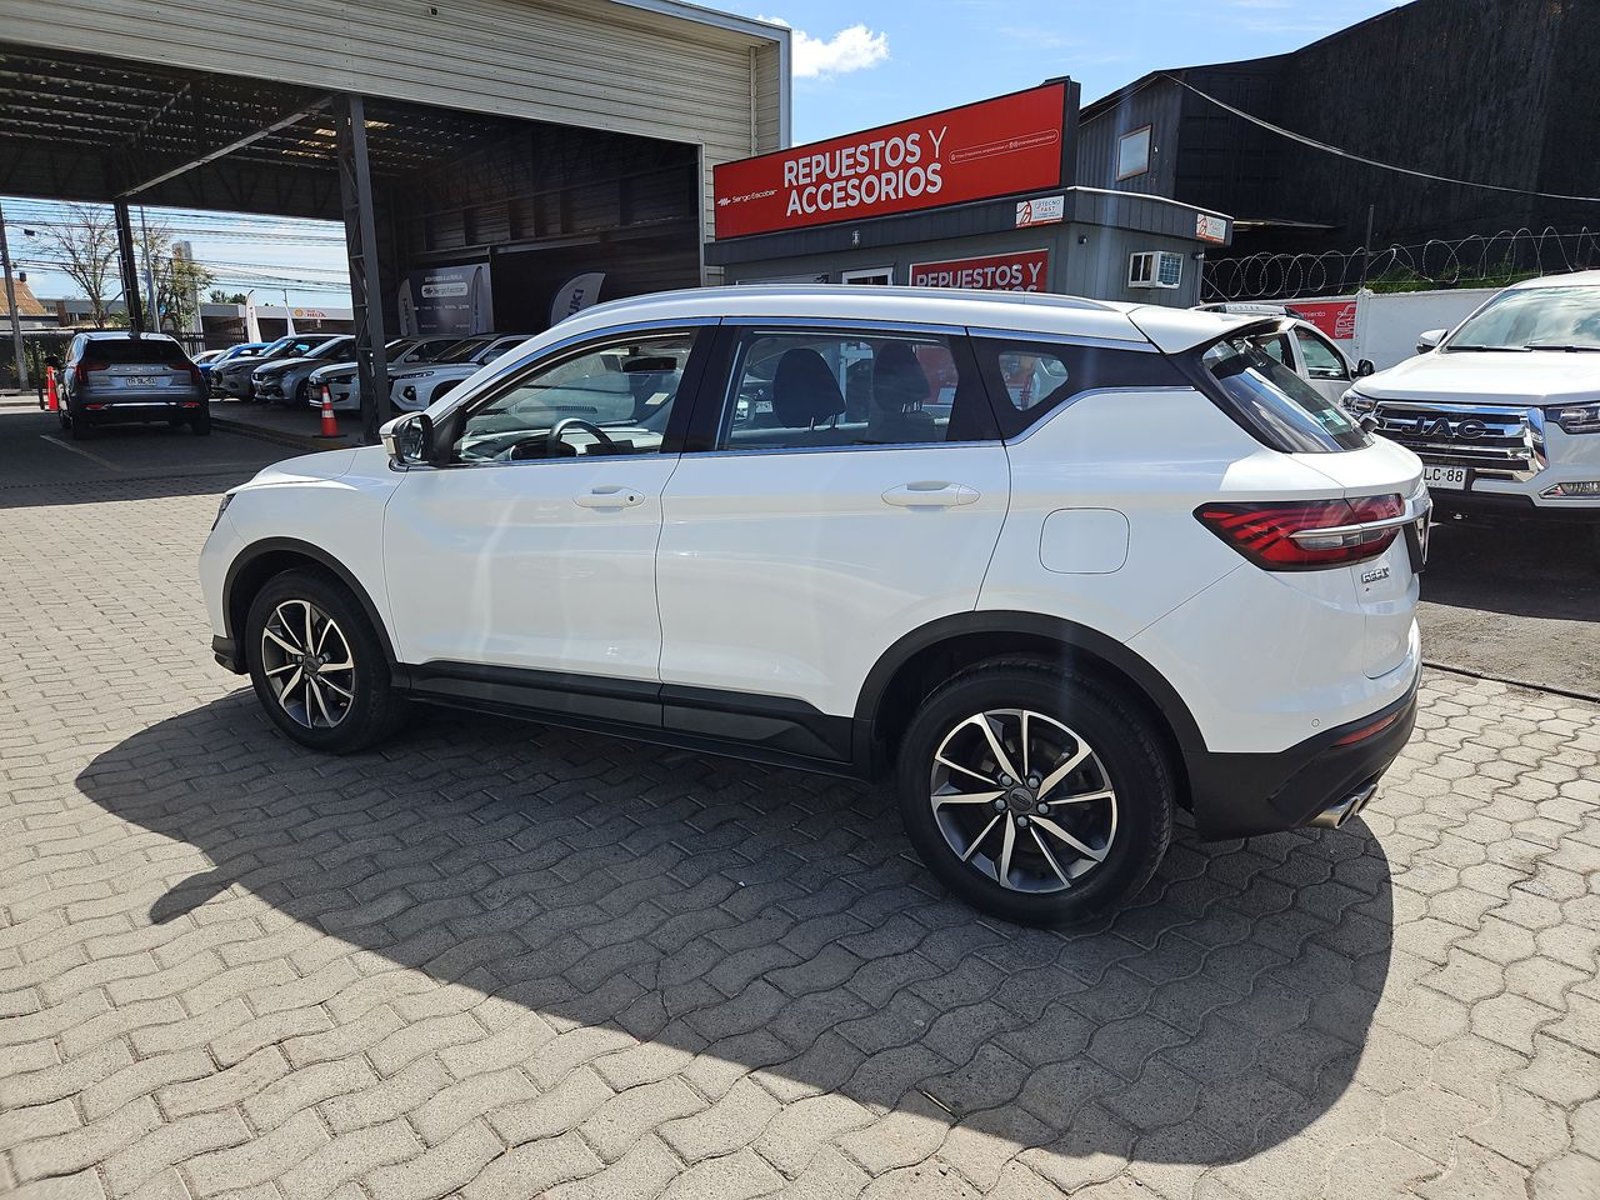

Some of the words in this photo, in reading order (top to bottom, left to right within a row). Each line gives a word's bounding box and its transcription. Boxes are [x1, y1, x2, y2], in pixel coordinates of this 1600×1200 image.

[784, 133, 921, 188] REPUESTOS
[928, 126, 948, 159] Y
[786, 162, 943, 217] ACCESORIOS
[1028, 262, 1043, 283] Y
[1401, 416, 1487, 439] JAC
